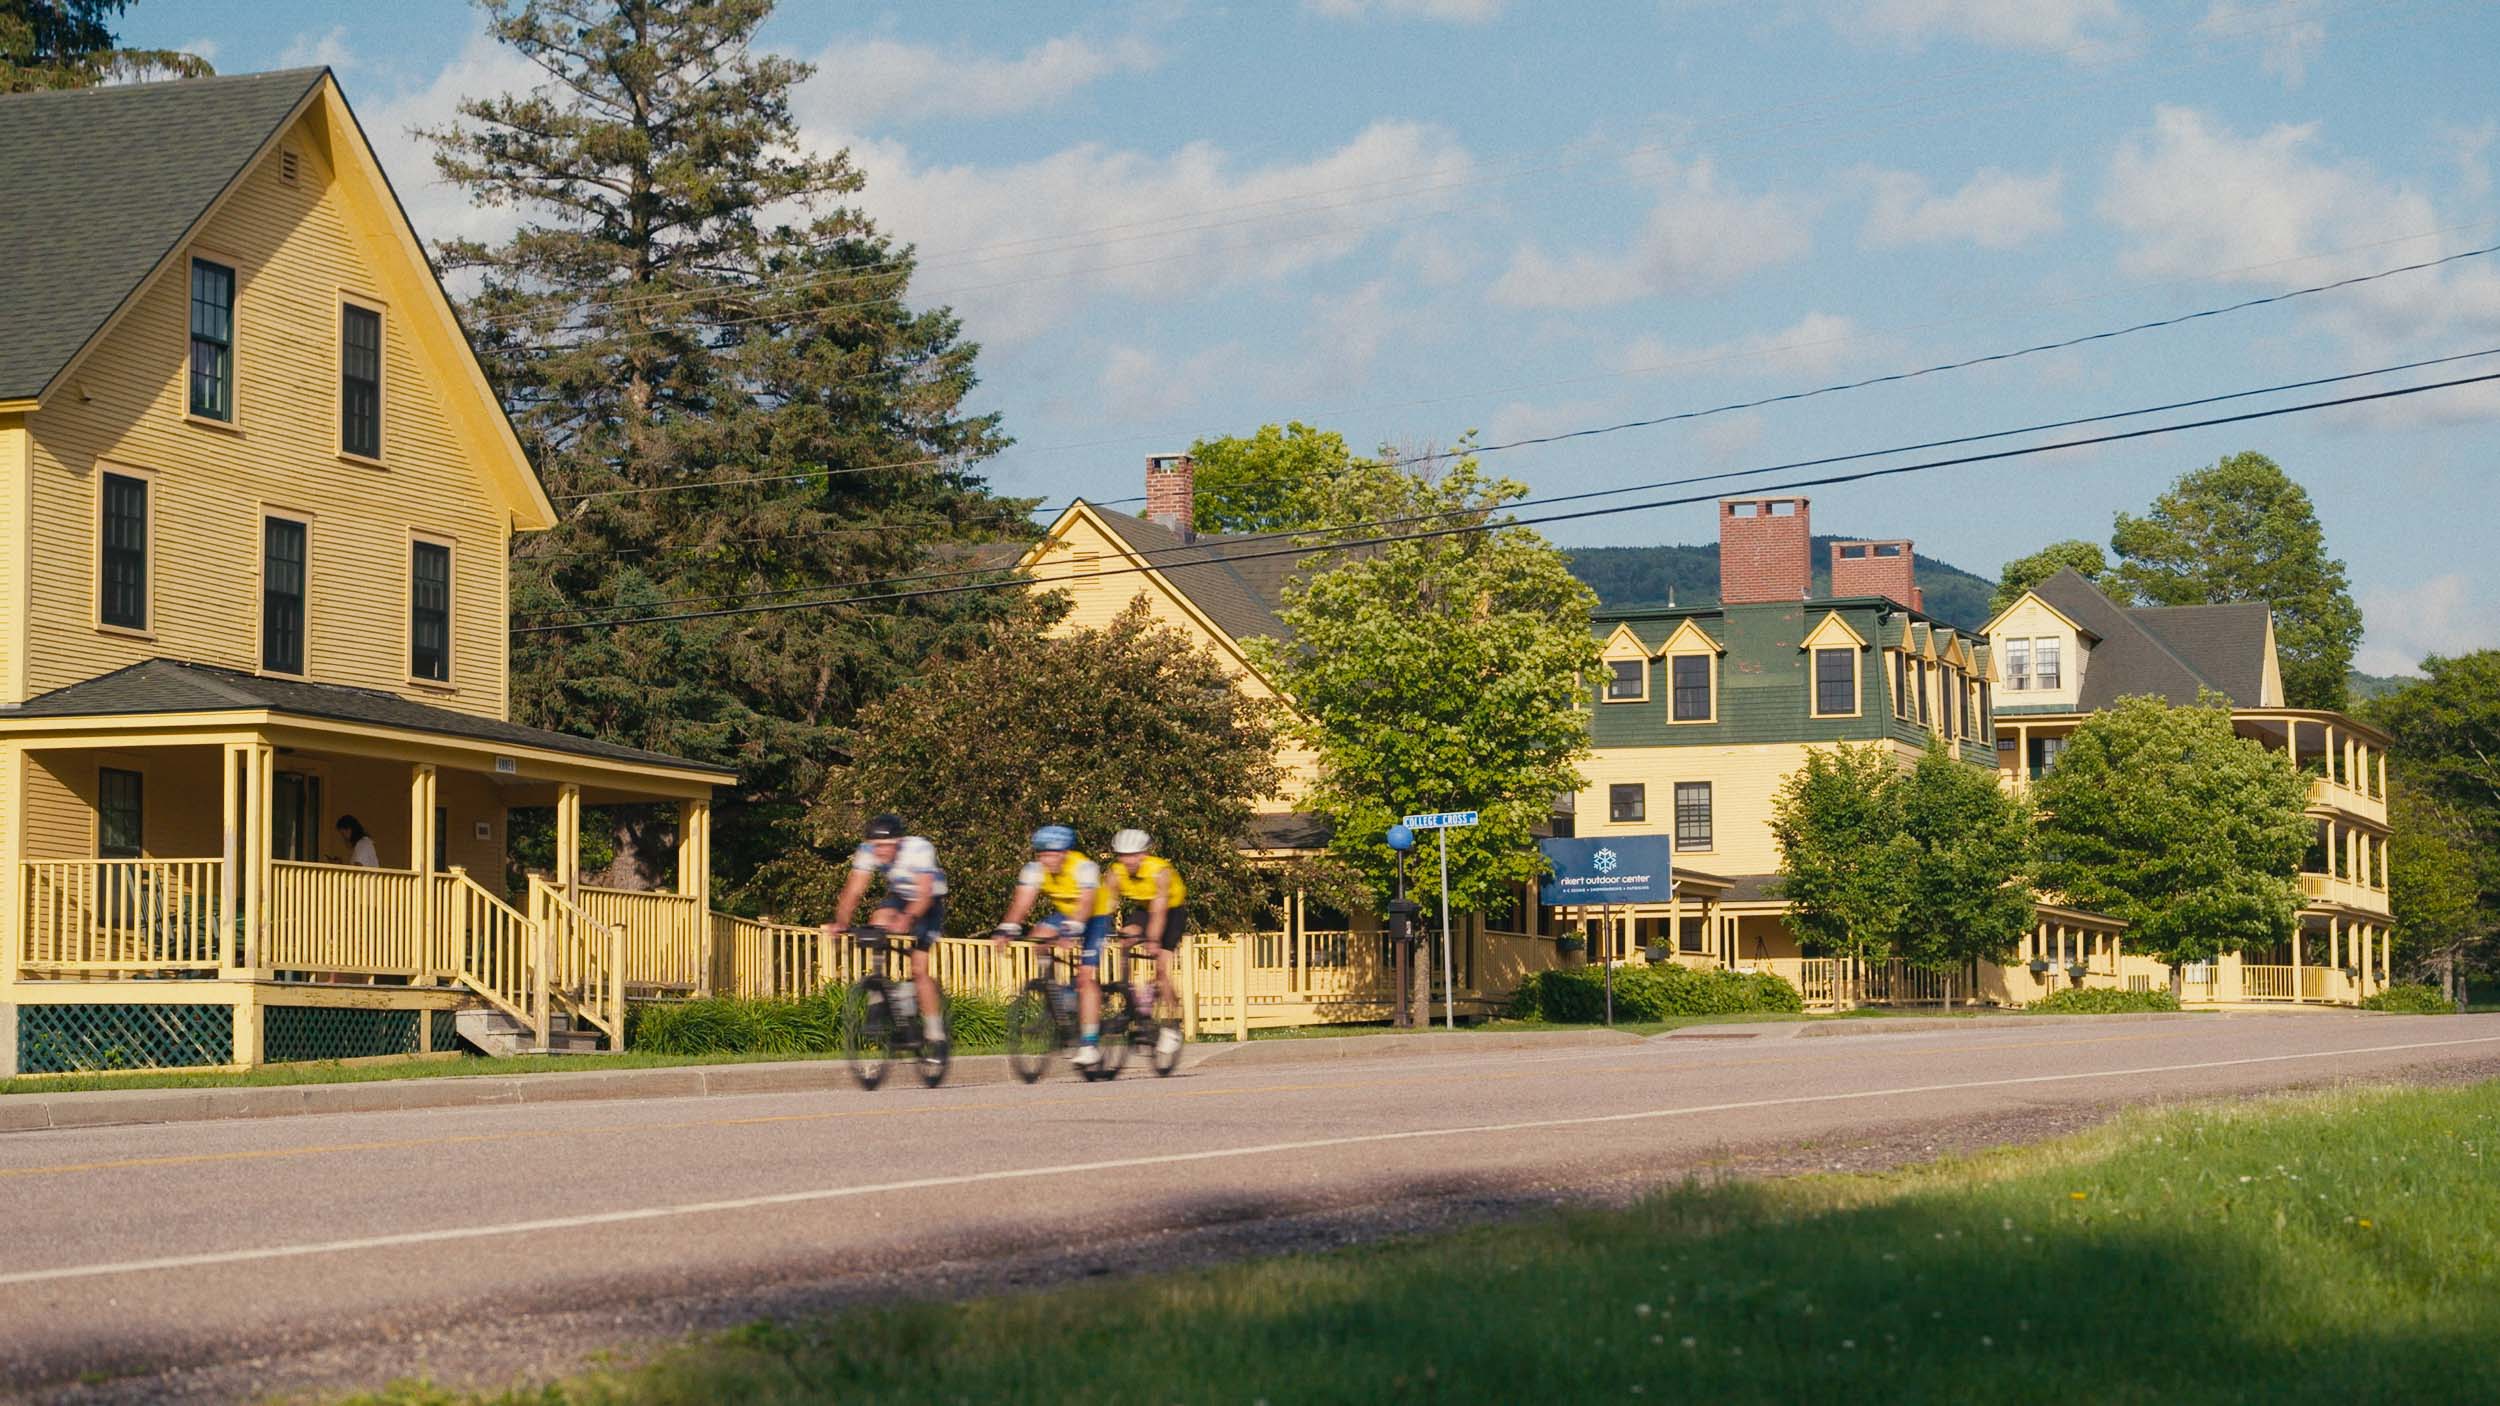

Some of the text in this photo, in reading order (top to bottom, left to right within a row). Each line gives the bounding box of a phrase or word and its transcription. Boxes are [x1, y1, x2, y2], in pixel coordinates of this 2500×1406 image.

[1405, 815, 1438, 827] COLLEGE
[1442, 814, 1467, 825] CROSS
[1586, 876, 1621, 885] outdoor
[1622, 874, 1650, 883] center
